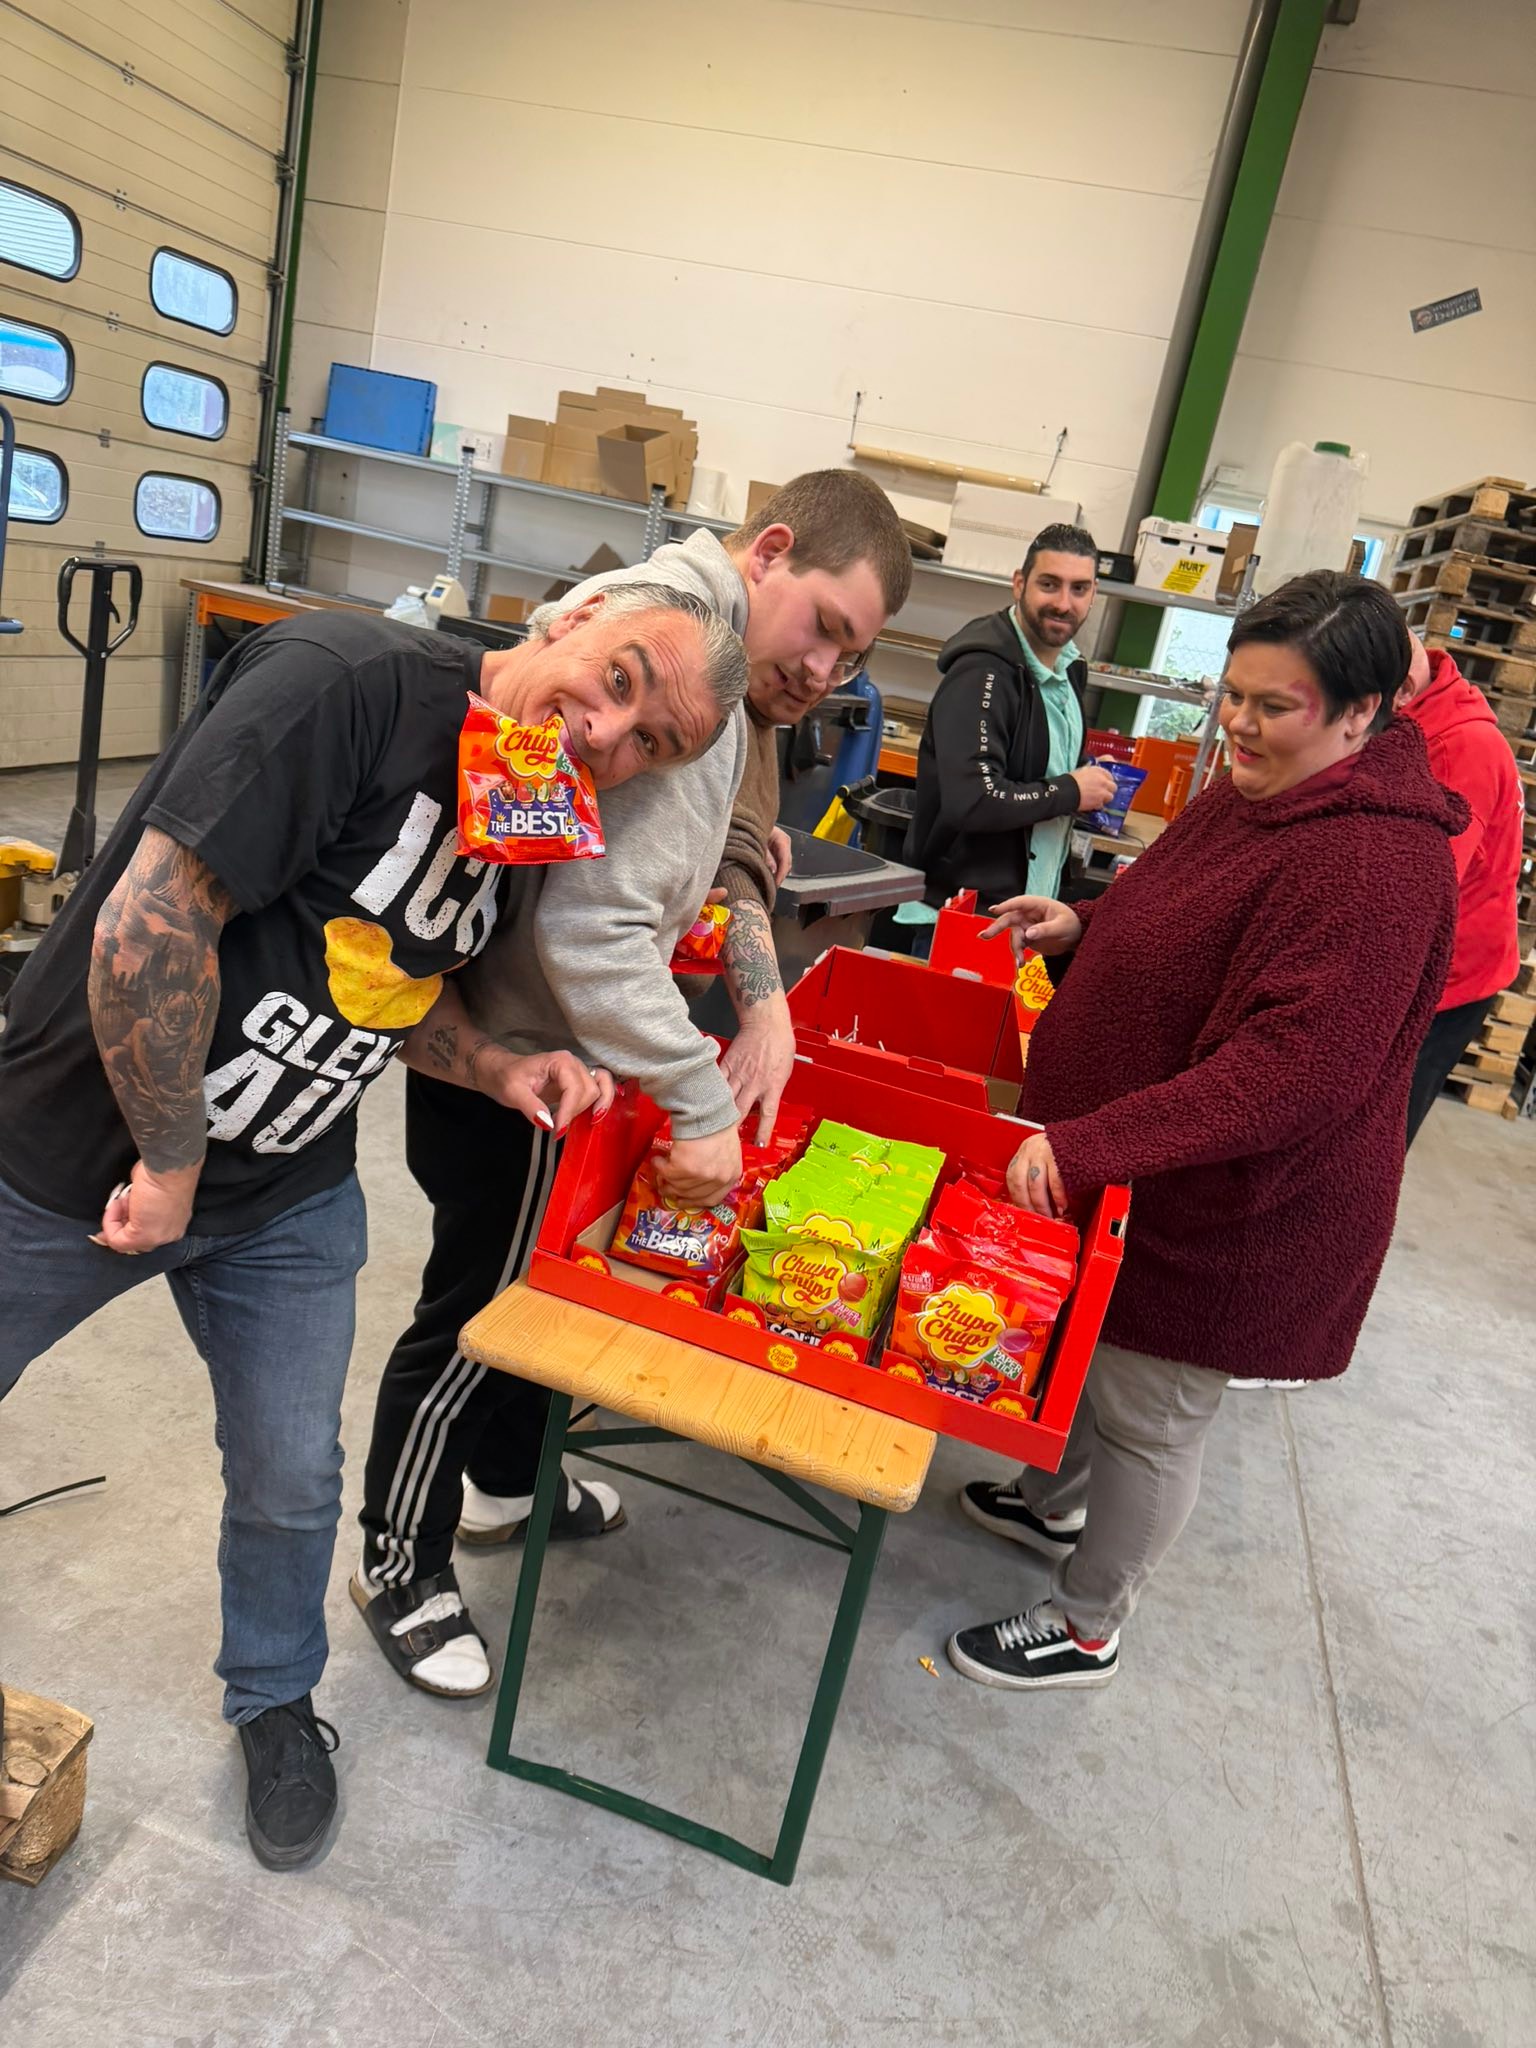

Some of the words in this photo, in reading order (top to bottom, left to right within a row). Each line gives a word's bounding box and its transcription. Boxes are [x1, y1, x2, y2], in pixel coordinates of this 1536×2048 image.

[503, 730, 558, 766] Chup
[490, 820, 510, 833] THE
[511, 810, 567, 835] BEST
[566, 825, 580, 835] OF
[204, 1048, 363, 1154] AU
[631, 1234, 648, 1246] THE
[782, 1254, 840, 1281] Chupa
[779, 1273, 833, 1305] Chups
[935, 1301, 999, 1333] Chupa
[925, 1319, 991, 1355] Chups
[990, 1359, 1017, 1378] STICK
[994, 1348, 1022, 1373] PAPER
